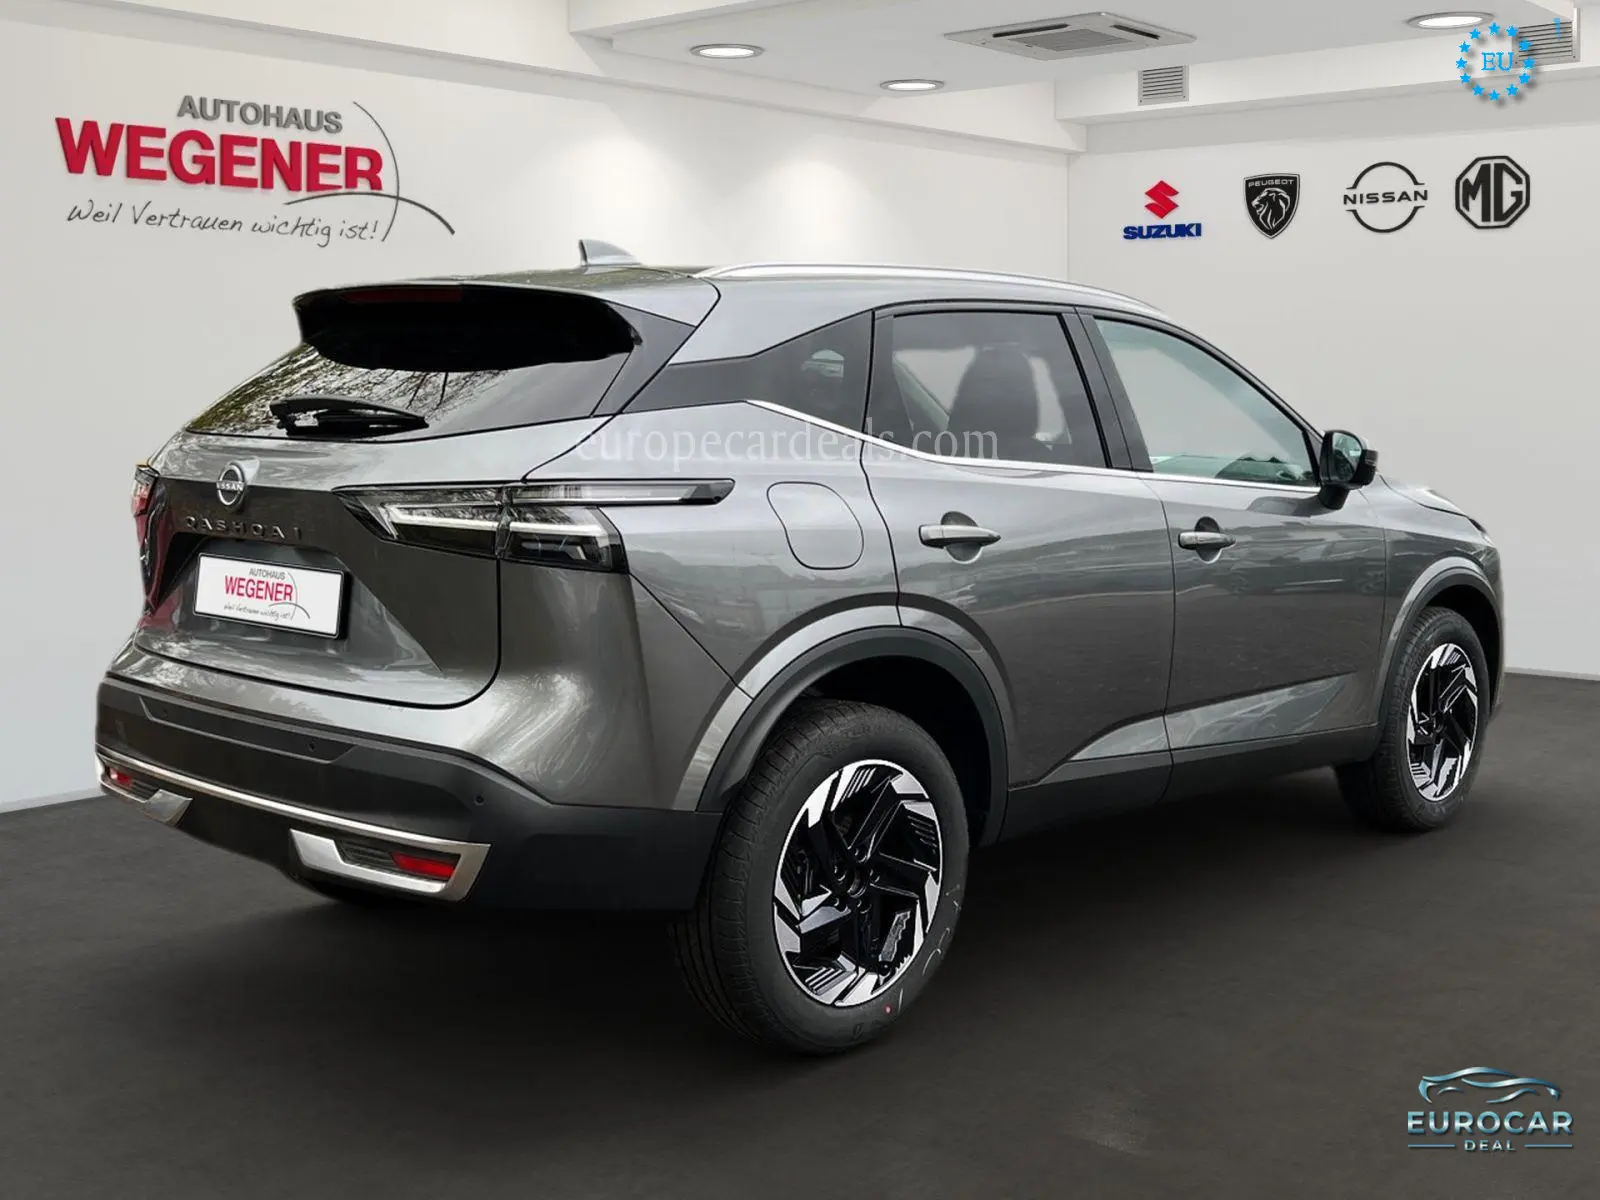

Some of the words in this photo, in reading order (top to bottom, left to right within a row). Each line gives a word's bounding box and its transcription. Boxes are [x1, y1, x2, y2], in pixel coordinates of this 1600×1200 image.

[177, 95, 343, 134] AUTOHAUS
[55, 117, 384, 193] WEGENER
[1248, 179, 1295, 188] PEUGEOT
[1461, 162, 1525, 224] MG
[1343, 189, 1428, 206] NISSAN
[67, 200, 123, 224] Weil
[132, 201, 244, 232] Vertrauen
[251, 215, 332, 248] wichtig
[339, 220, 378, 241] ist!
[1122, 222, 1202, 240] SUZUKI
[249, 568, 286, 580] AUTOHAUS
[225, 575, 293, 601] WEGENER
